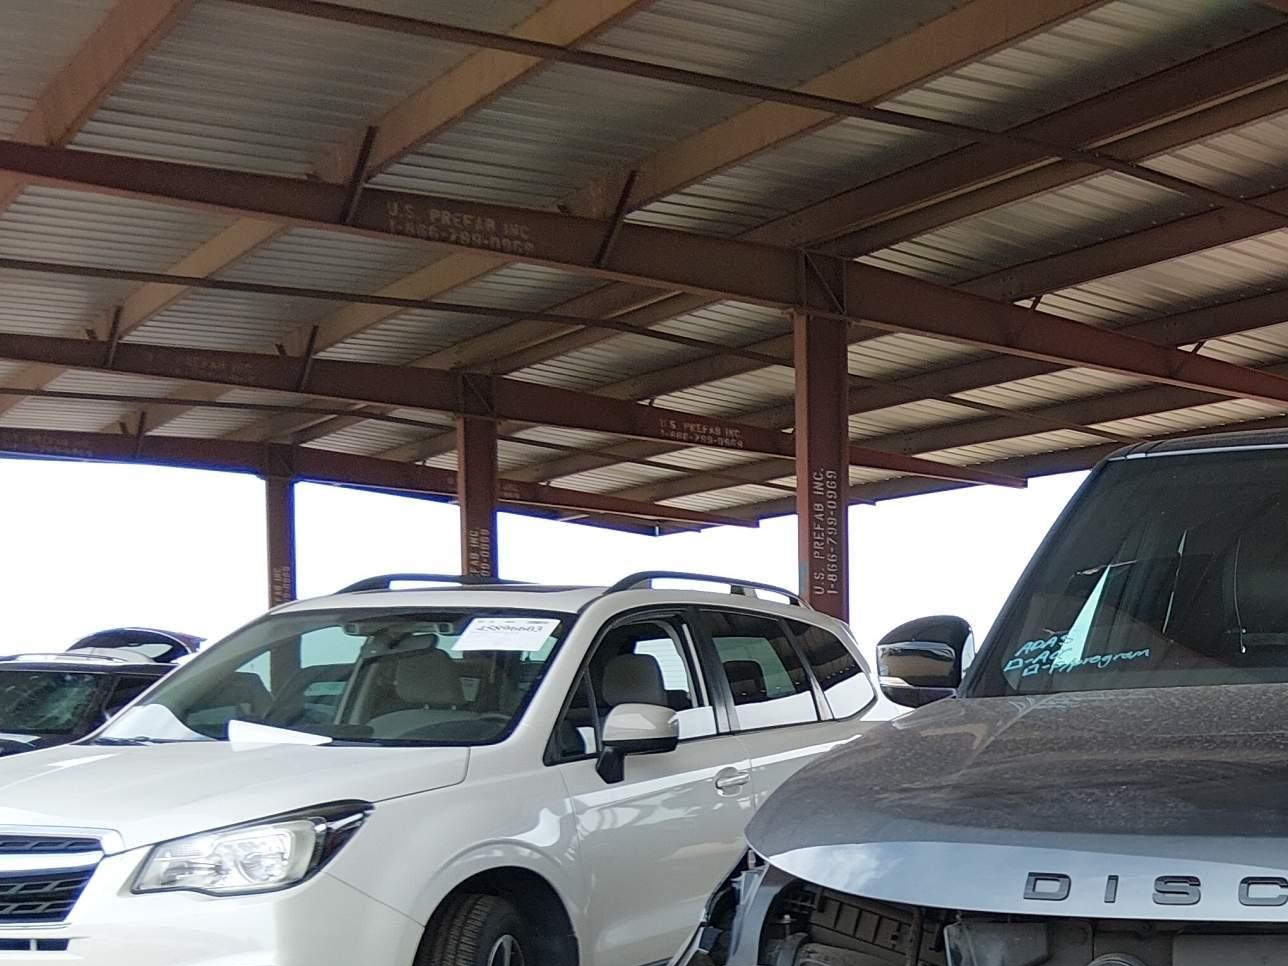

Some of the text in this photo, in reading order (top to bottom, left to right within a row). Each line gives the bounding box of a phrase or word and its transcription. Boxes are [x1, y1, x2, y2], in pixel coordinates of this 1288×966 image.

[813, 467, 825, 595] U.S. PREFAB INC.
[826, 470, 838, 595] 1-866-799-0969
